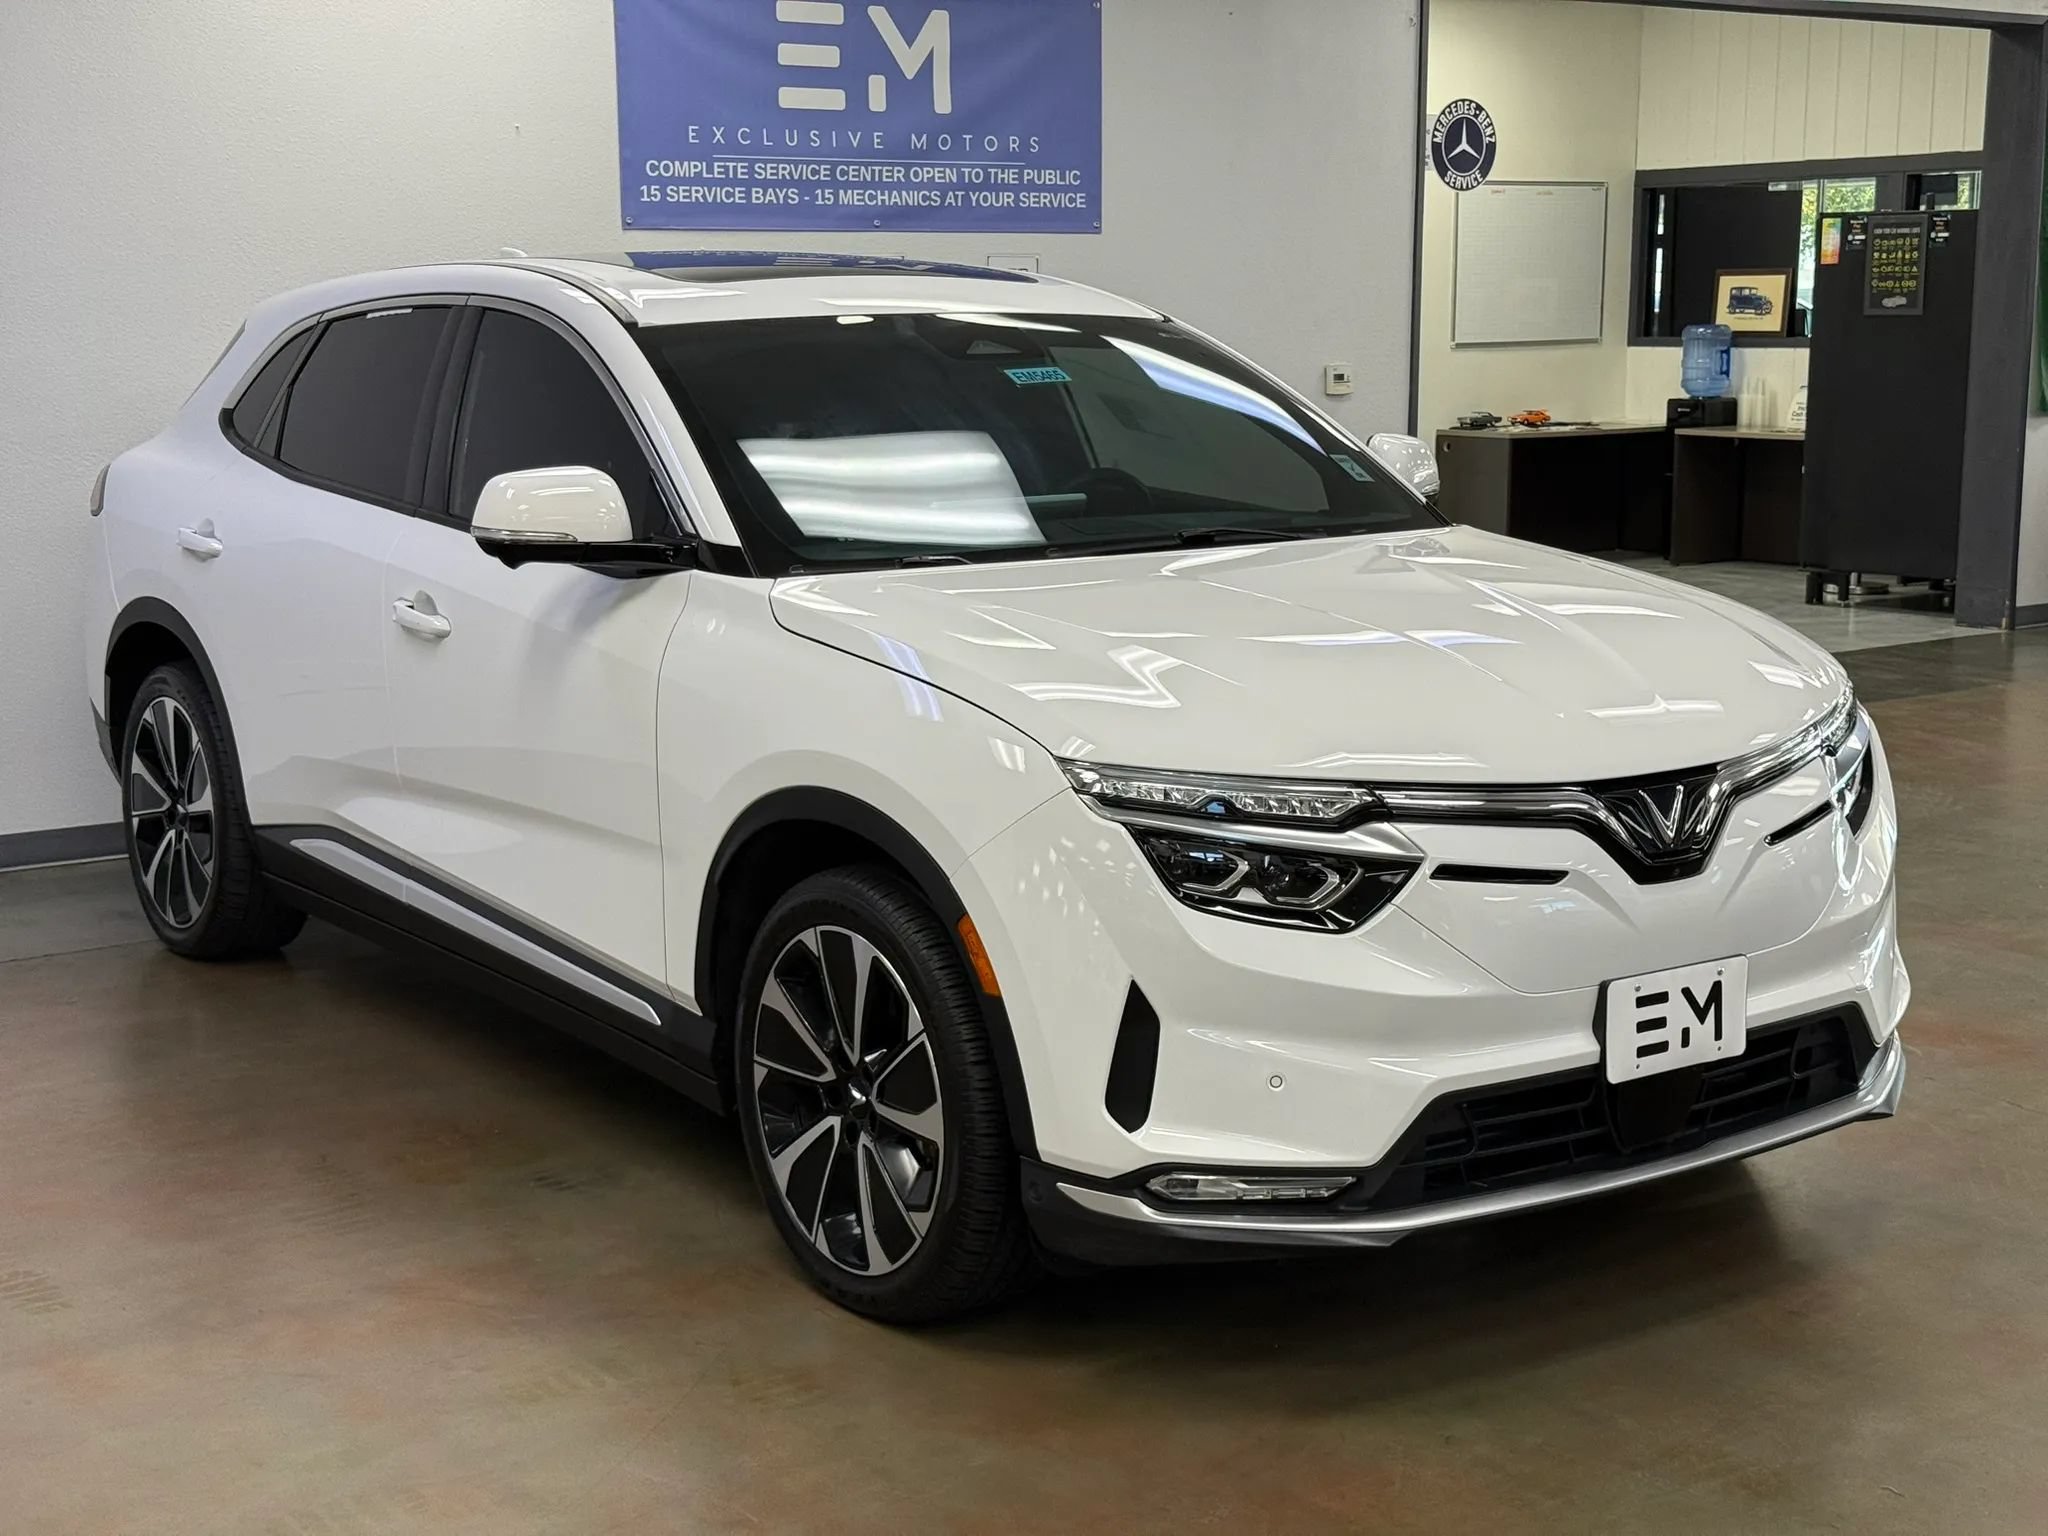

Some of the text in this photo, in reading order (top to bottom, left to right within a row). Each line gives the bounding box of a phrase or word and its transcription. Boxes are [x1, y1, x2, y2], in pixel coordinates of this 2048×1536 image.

[776, 0, 952, 114] EM
[688, 125, 1040, 153] EXCLUSIVE MOTORS
[645, 159, 1081, 186] COMPLETE SERVICE CENTER OPEN TO THE PUBLIC
[1444, 169, 1484, 190] SERVICE
[640, 185, 661, 202] 15
[666, 185, 747, 204] SERVICE
[751, 187, 800, 205] BAYS
[815, 189, 834, 205] 15
[838, 189, 941, 207] MECHANICS
[944, 191, 965, 207] AT
[969, 191, 1015, 208] YOUR
[1018, 192, 1087, 209] SERVICE
[1635, 979, 1723, 1059] EM
